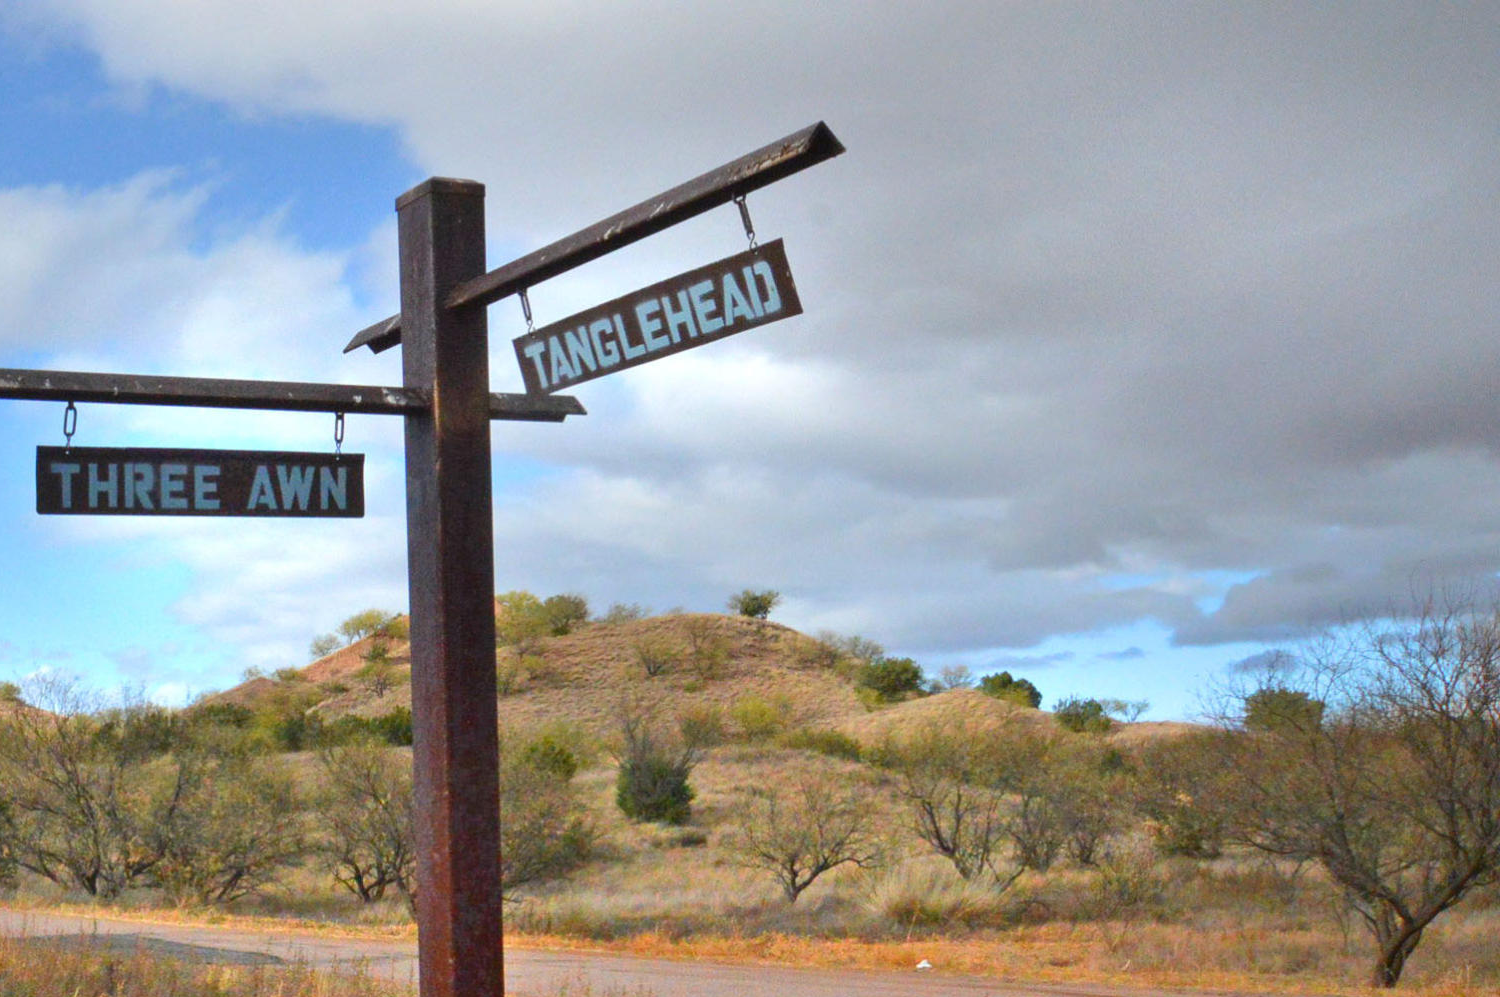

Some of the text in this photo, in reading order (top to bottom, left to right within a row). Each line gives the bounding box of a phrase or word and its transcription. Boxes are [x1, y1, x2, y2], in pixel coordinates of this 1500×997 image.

[523, 260, 782, 389] TANGLEHEAD
[50, 462, 348, 511] THREE AWN
